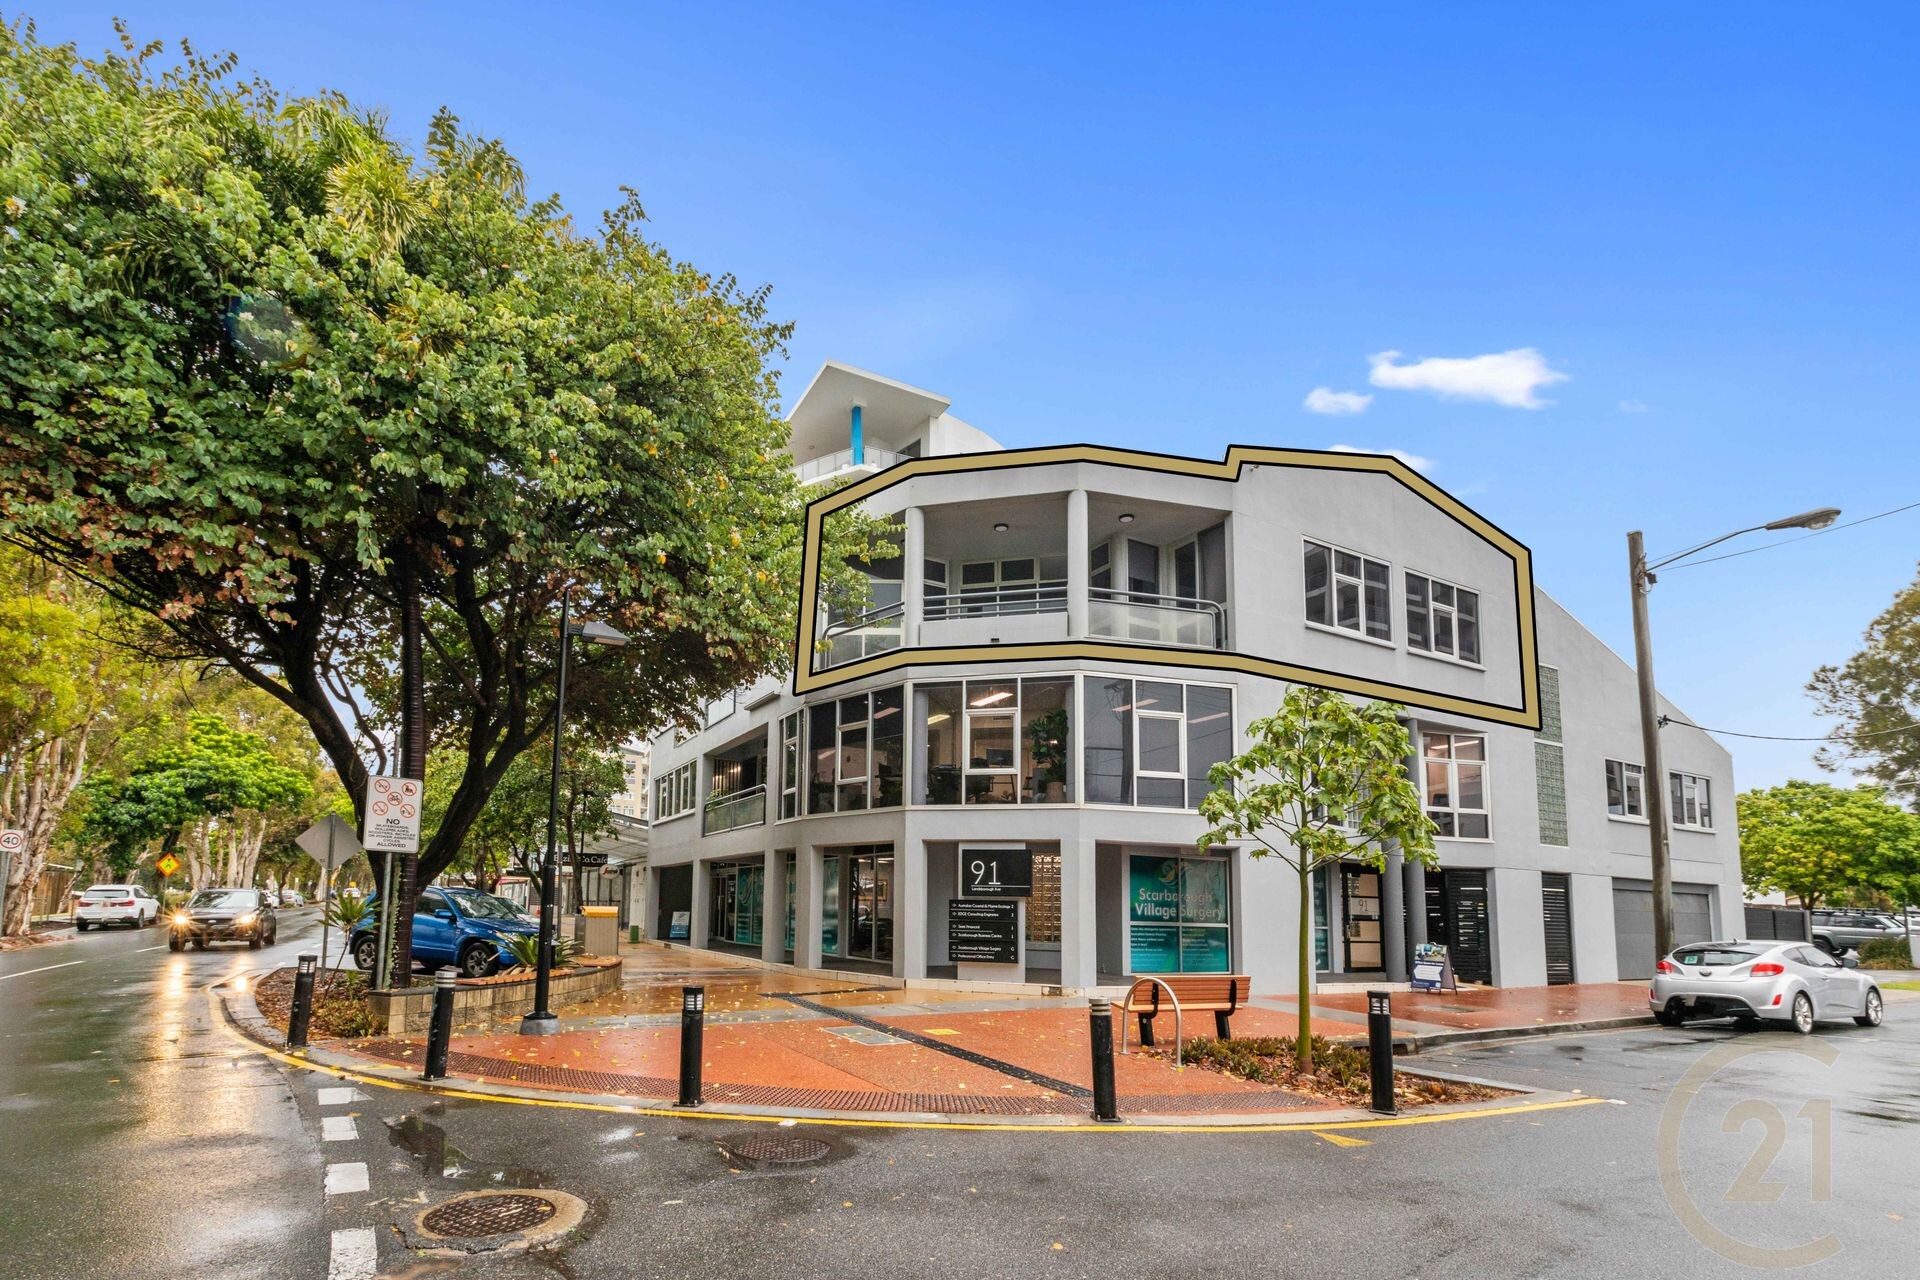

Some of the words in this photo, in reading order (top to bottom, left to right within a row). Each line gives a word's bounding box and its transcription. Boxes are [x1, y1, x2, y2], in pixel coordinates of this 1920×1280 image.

[3, 836, 19, 845] 40
[971, 860, 1001, 885] 91
[1135, 902, 1177, 920] Village
[1179, 904, 1223, 921] Surgery
[1359, 899, 1369, 912] 91
